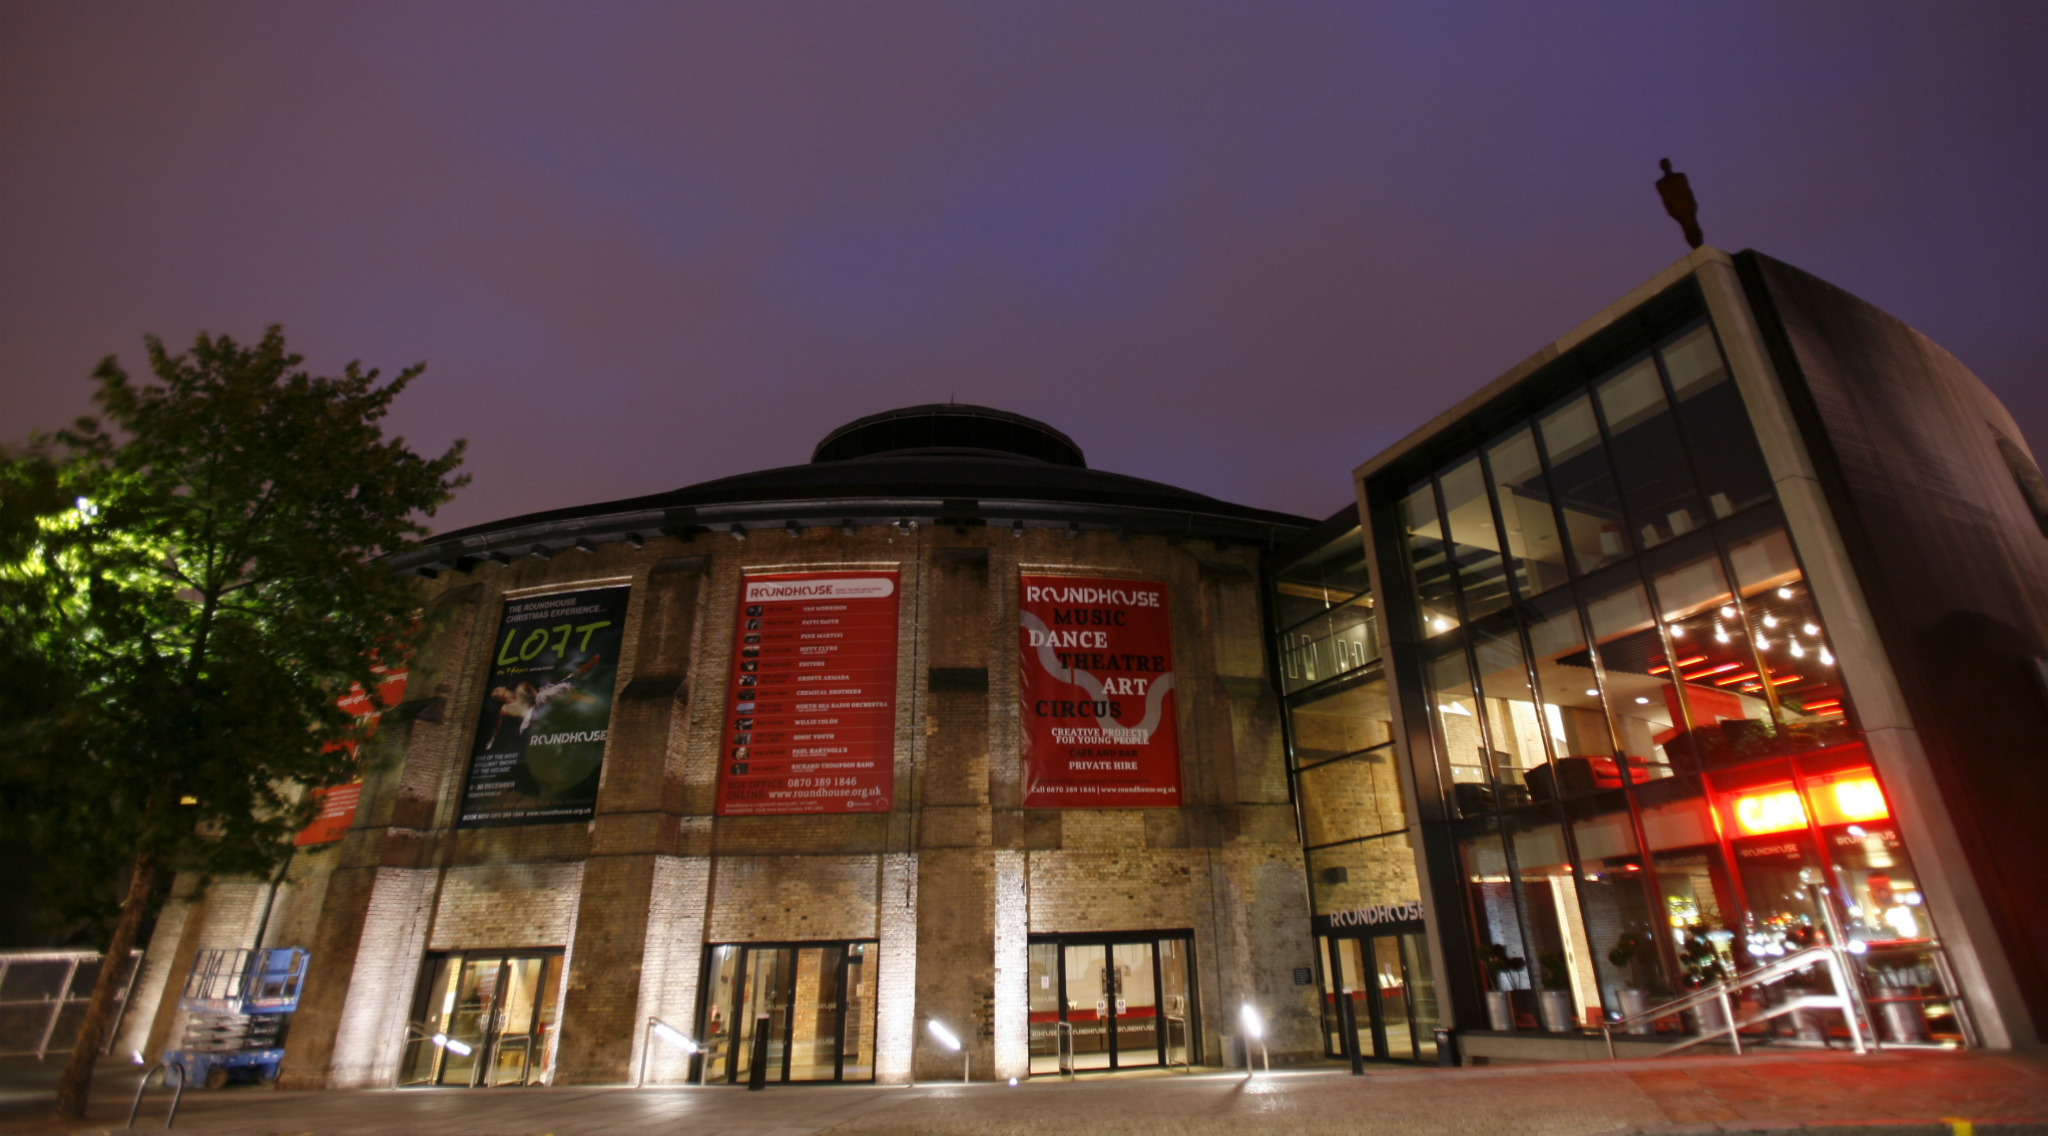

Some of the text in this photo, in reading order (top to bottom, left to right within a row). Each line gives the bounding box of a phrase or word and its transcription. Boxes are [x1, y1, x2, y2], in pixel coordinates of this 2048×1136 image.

[750, 585, 833, 598] ROUNDHOUSE
[1027, 586, 1160, 608] ROUNDHOUSE
[509, 598, 577, 614] THE ROUNDHOUSE
[506, 610, 549, 623] CHRISTMAS
[1053, 608, 1126, 626] MUSIC
[1029, 629, 1108, 649] DANCE
[1058, 653, 1165, 673] THEATRE
[1102, 677, 1148, 696] ART
[1035, 700, 1122, 719] CIRCUS
[529, 730, 608, 746] ROUNDHOUSE
[1051, 727, 1149, 737] CREATIVE PROJECTS
[1056, 736, 1150, 745] FOR YOUNG PEOPLE
[1068, 761, 1138, 771] PRIVATE HIRE
[787, 776, 857, 788] 0870 389 1846
[768, 786, 882, 800] www.roundhouse.org.uk
